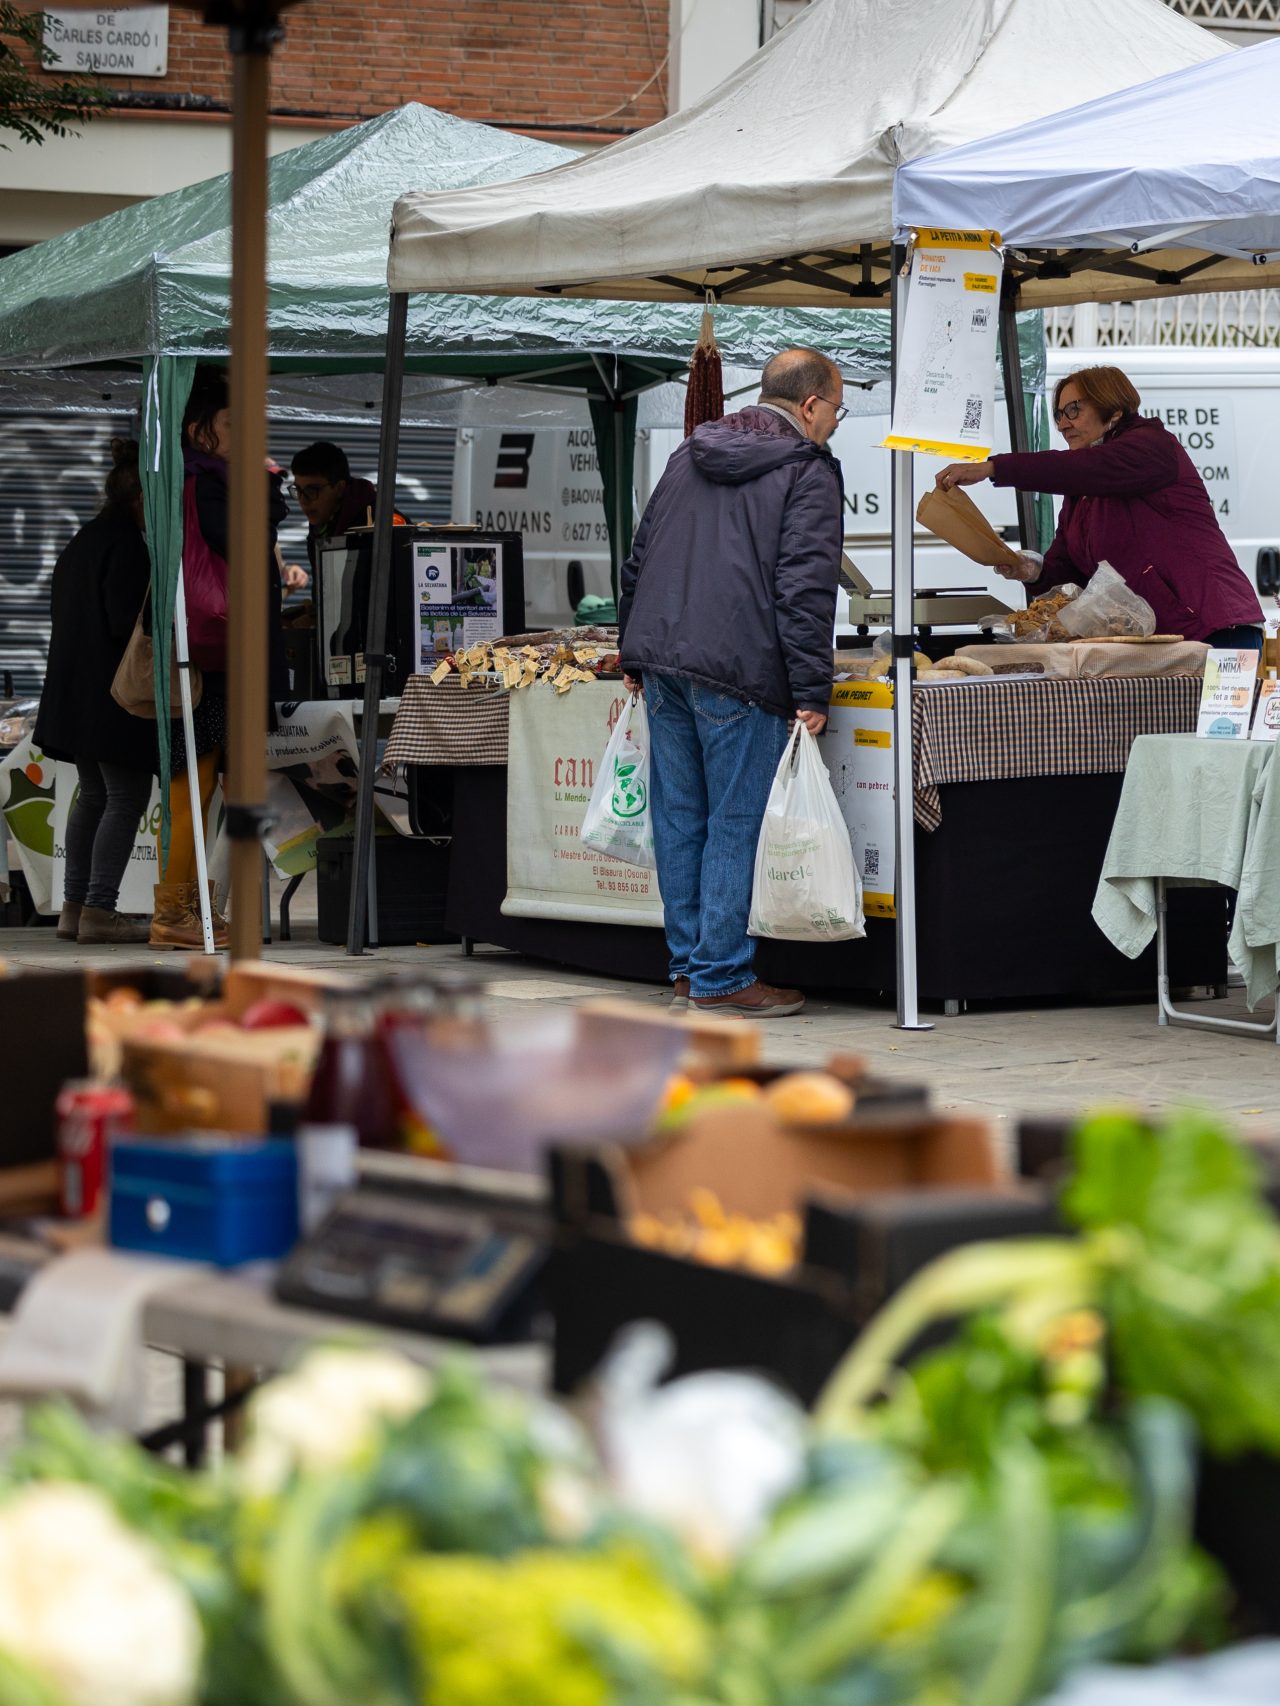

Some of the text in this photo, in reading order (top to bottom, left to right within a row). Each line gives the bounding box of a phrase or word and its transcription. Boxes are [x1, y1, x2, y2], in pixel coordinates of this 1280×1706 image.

[96, 14, 115, 26] DE
[53, 28, 159, 48] CARLES CARDÓ I
[76, 51, 135, 69] SANJOAN
[930, 230, 940, 241] LA
[941, 231, 963, 242] PETITA
[1195, 408, 1219, 426] DE
[476, 511, 552, 533] BAOVANS
[572, 523, 592, 541] 627
[836, 690, 850, 700] CAN
[1213, 693, 1222, 701] fet
[553, 756, 595, 788] can
[564, 792, 587, 803] Mendo
[554, 824, 579, 837] CARNS
[560, 850, 582, 860] Mestre
[592, 865, 600, 876] El
[624, 868, 652, 882] (Osona)
[596, 880, 649, 894] Tel. 93 855 03 28
